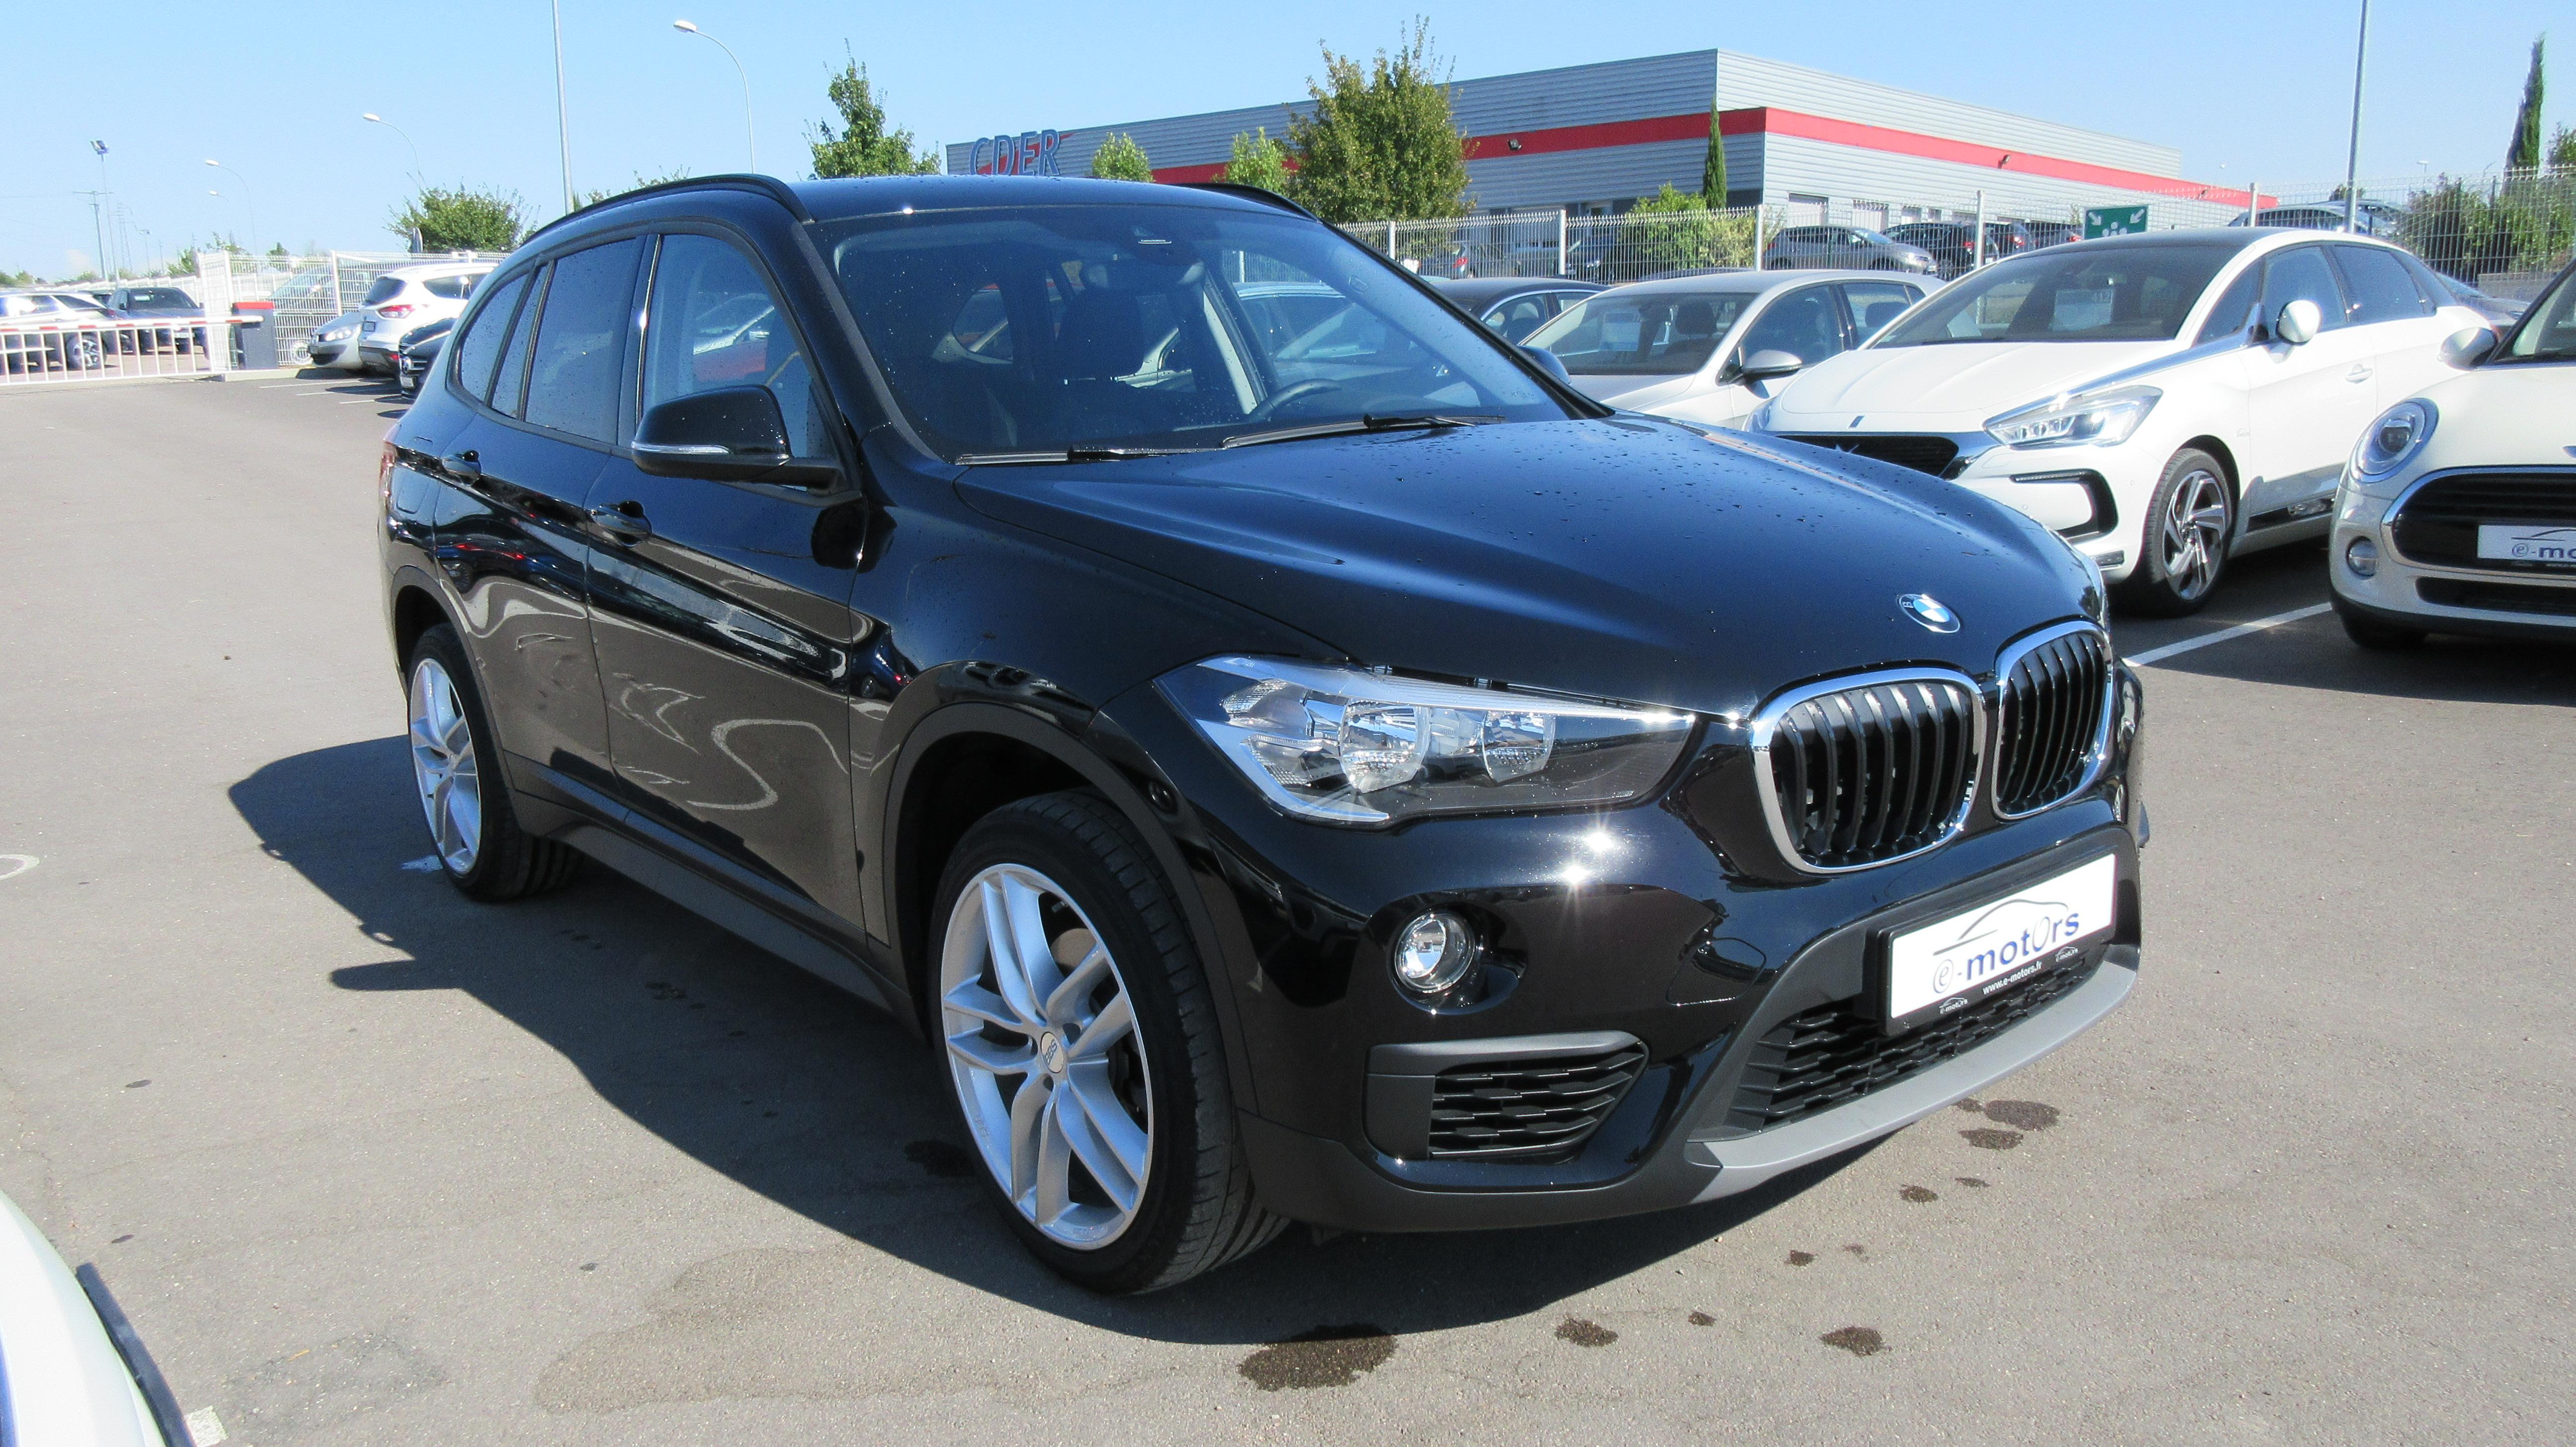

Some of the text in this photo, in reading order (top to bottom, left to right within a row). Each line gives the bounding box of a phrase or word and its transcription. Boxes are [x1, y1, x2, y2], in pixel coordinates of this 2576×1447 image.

[969, 129, 1060, 176] CDER
[1982, 960, 2042, 995] www.e-motors.fr
[1045, 1038, 1057, 1066] BBS
